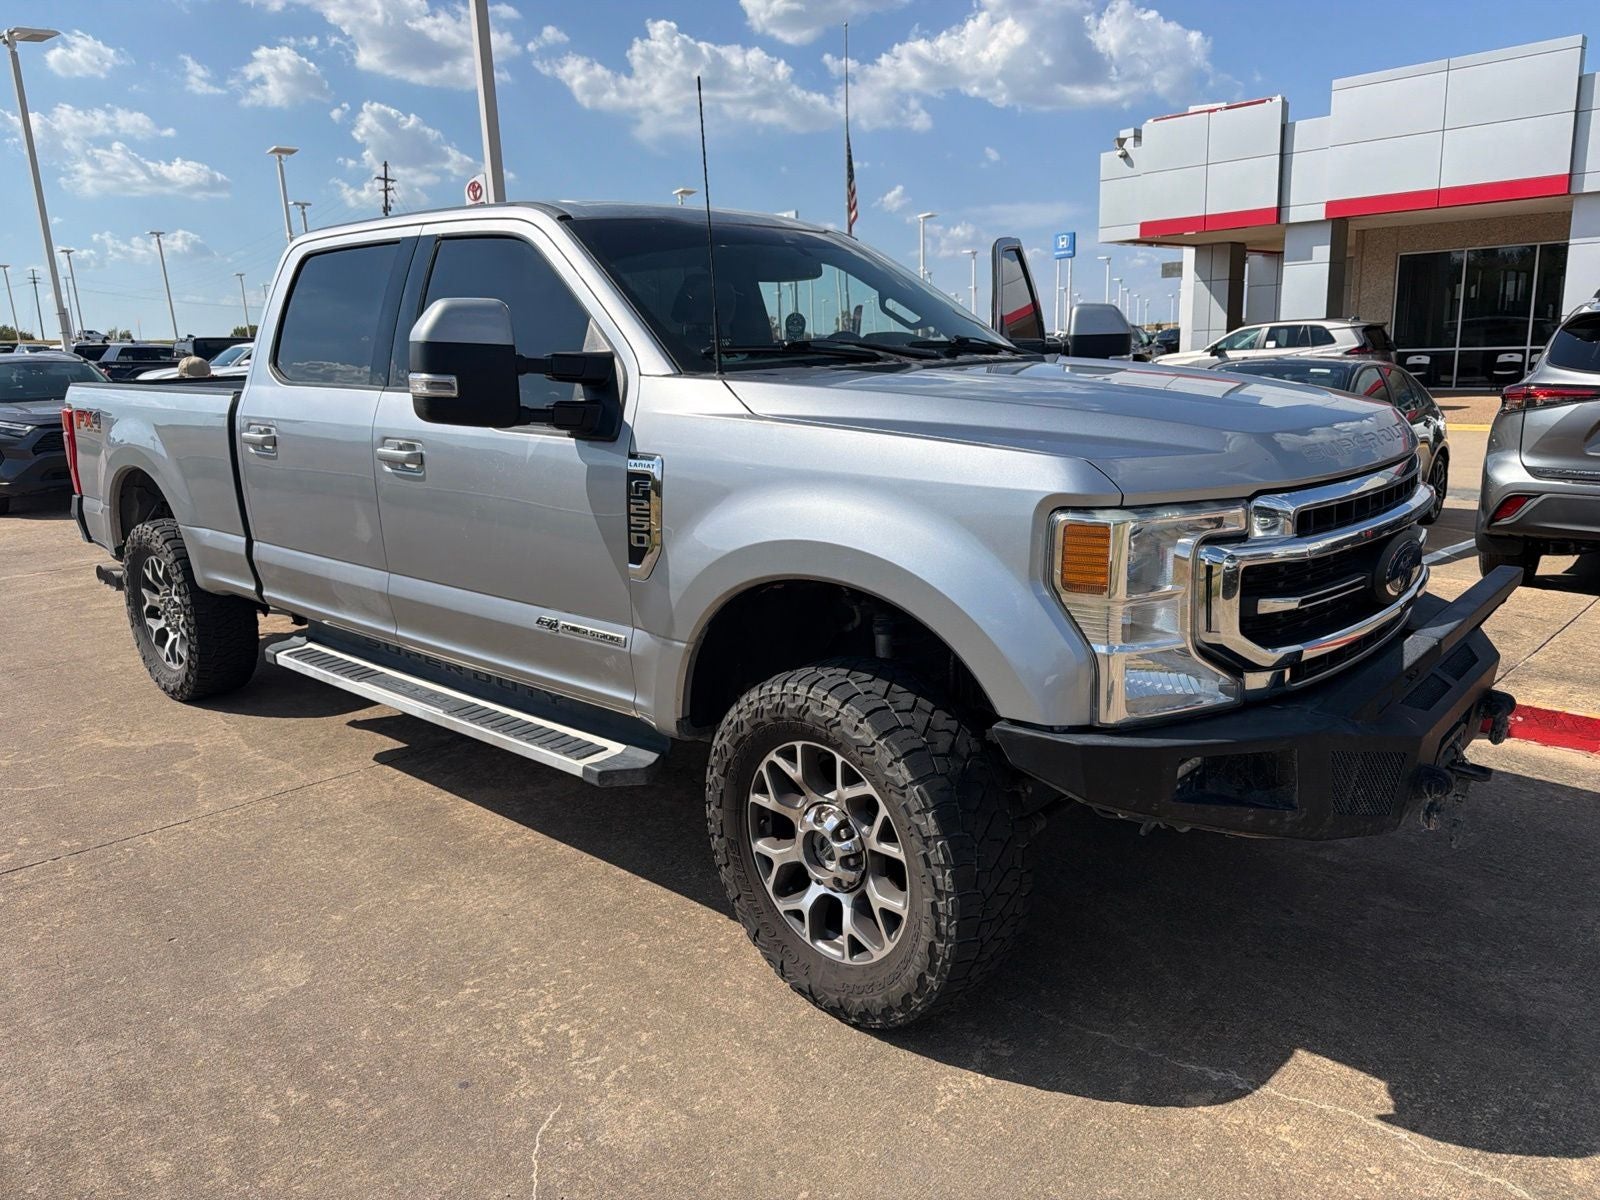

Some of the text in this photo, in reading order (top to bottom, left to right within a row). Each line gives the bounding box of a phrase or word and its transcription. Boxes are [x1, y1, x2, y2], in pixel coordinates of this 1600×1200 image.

[75, 410, 102, 430] FX4
[628, 462, 656, 471] LARIAT
[561, 623, 589, 637] POWER
[589, 630, 623, 645] STROKE
